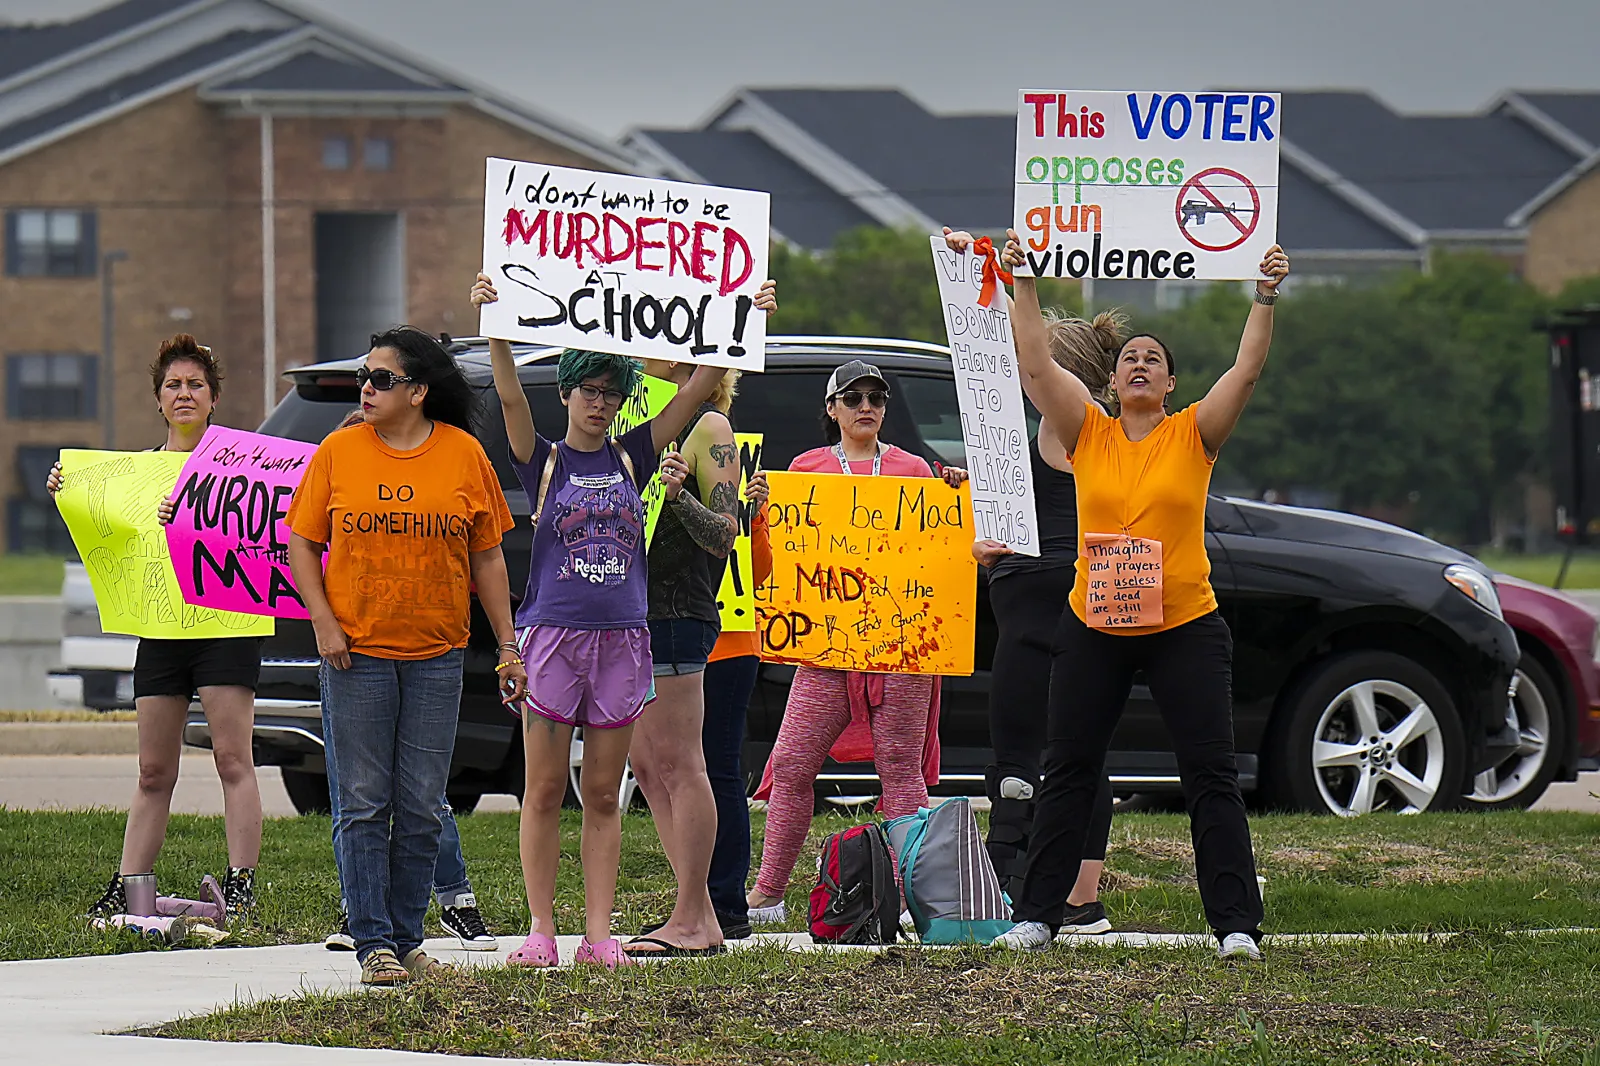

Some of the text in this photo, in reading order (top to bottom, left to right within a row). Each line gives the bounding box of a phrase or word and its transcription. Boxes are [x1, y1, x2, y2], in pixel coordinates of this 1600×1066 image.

[1024, 93, 1275, 141] This VOTER
[505, 165, 731, 221] I dont want to be
[1025, 156, 1185, 204] opposes
[1025, 203, 1102, 252] gun
[501, 202, 755, 297] MURDERED
[585, 270, 627, 291] AT
[500, 263, 753, 358] SCHOOL!
[954, 342, 1012, 378] Have
[967, 378, 1002, 412] To
[198, 435, 306, 474] I don't want
[962, 413, 1021, 460] Live
[169, 471, 300, 551] MURDE
[378, 484, 414, 502] DO
[769, 485, 822, 528] ont
[850, 486, 886, 530] be
[895, 486, 963, 532] Mad
[973, 500, 1029, 545] This
[236, 541, 290, 566] AT THE
[785, 535, 808, 554] at
[1088, 541, 1152, 560] Thoughts
[575, 557, 625, 583] Recycled
[754, 566, 779, 602] et
[795, 562, 865, 604] MAD
[871, 576, 889, 597] at
[902, 579, 935, 599] the
[1090, 560, 1160, 574] and prayers
[1091, 580, 1107, 588] are
[1089, 590, 1140, 603] The dead
[1093, 603, 1141, 614] are still
[851, 612, 923, 635] End Gun
